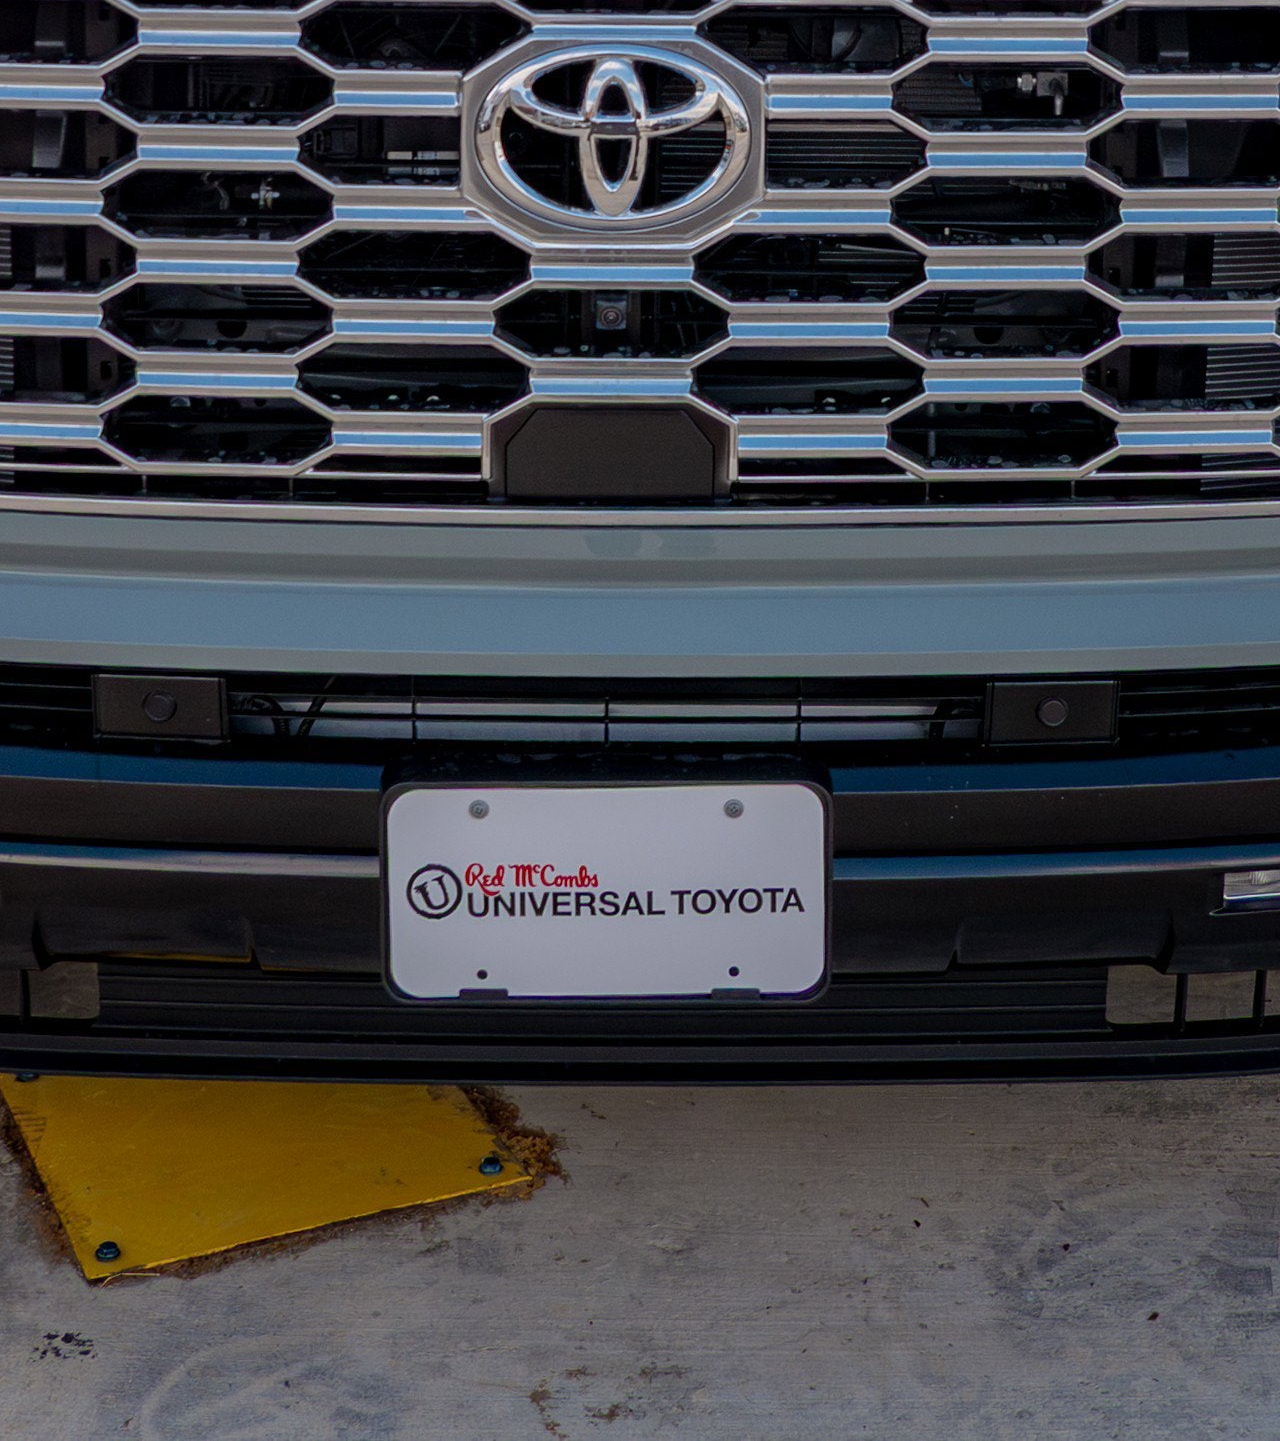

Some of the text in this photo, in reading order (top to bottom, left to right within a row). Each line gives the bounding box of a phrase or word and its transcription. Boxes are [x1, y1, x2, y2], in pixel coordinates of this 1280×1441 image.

[465, 862, 599, 896] Red McCombs
[467, 887, 806, 918] UNIVERSAL TOYOTA
